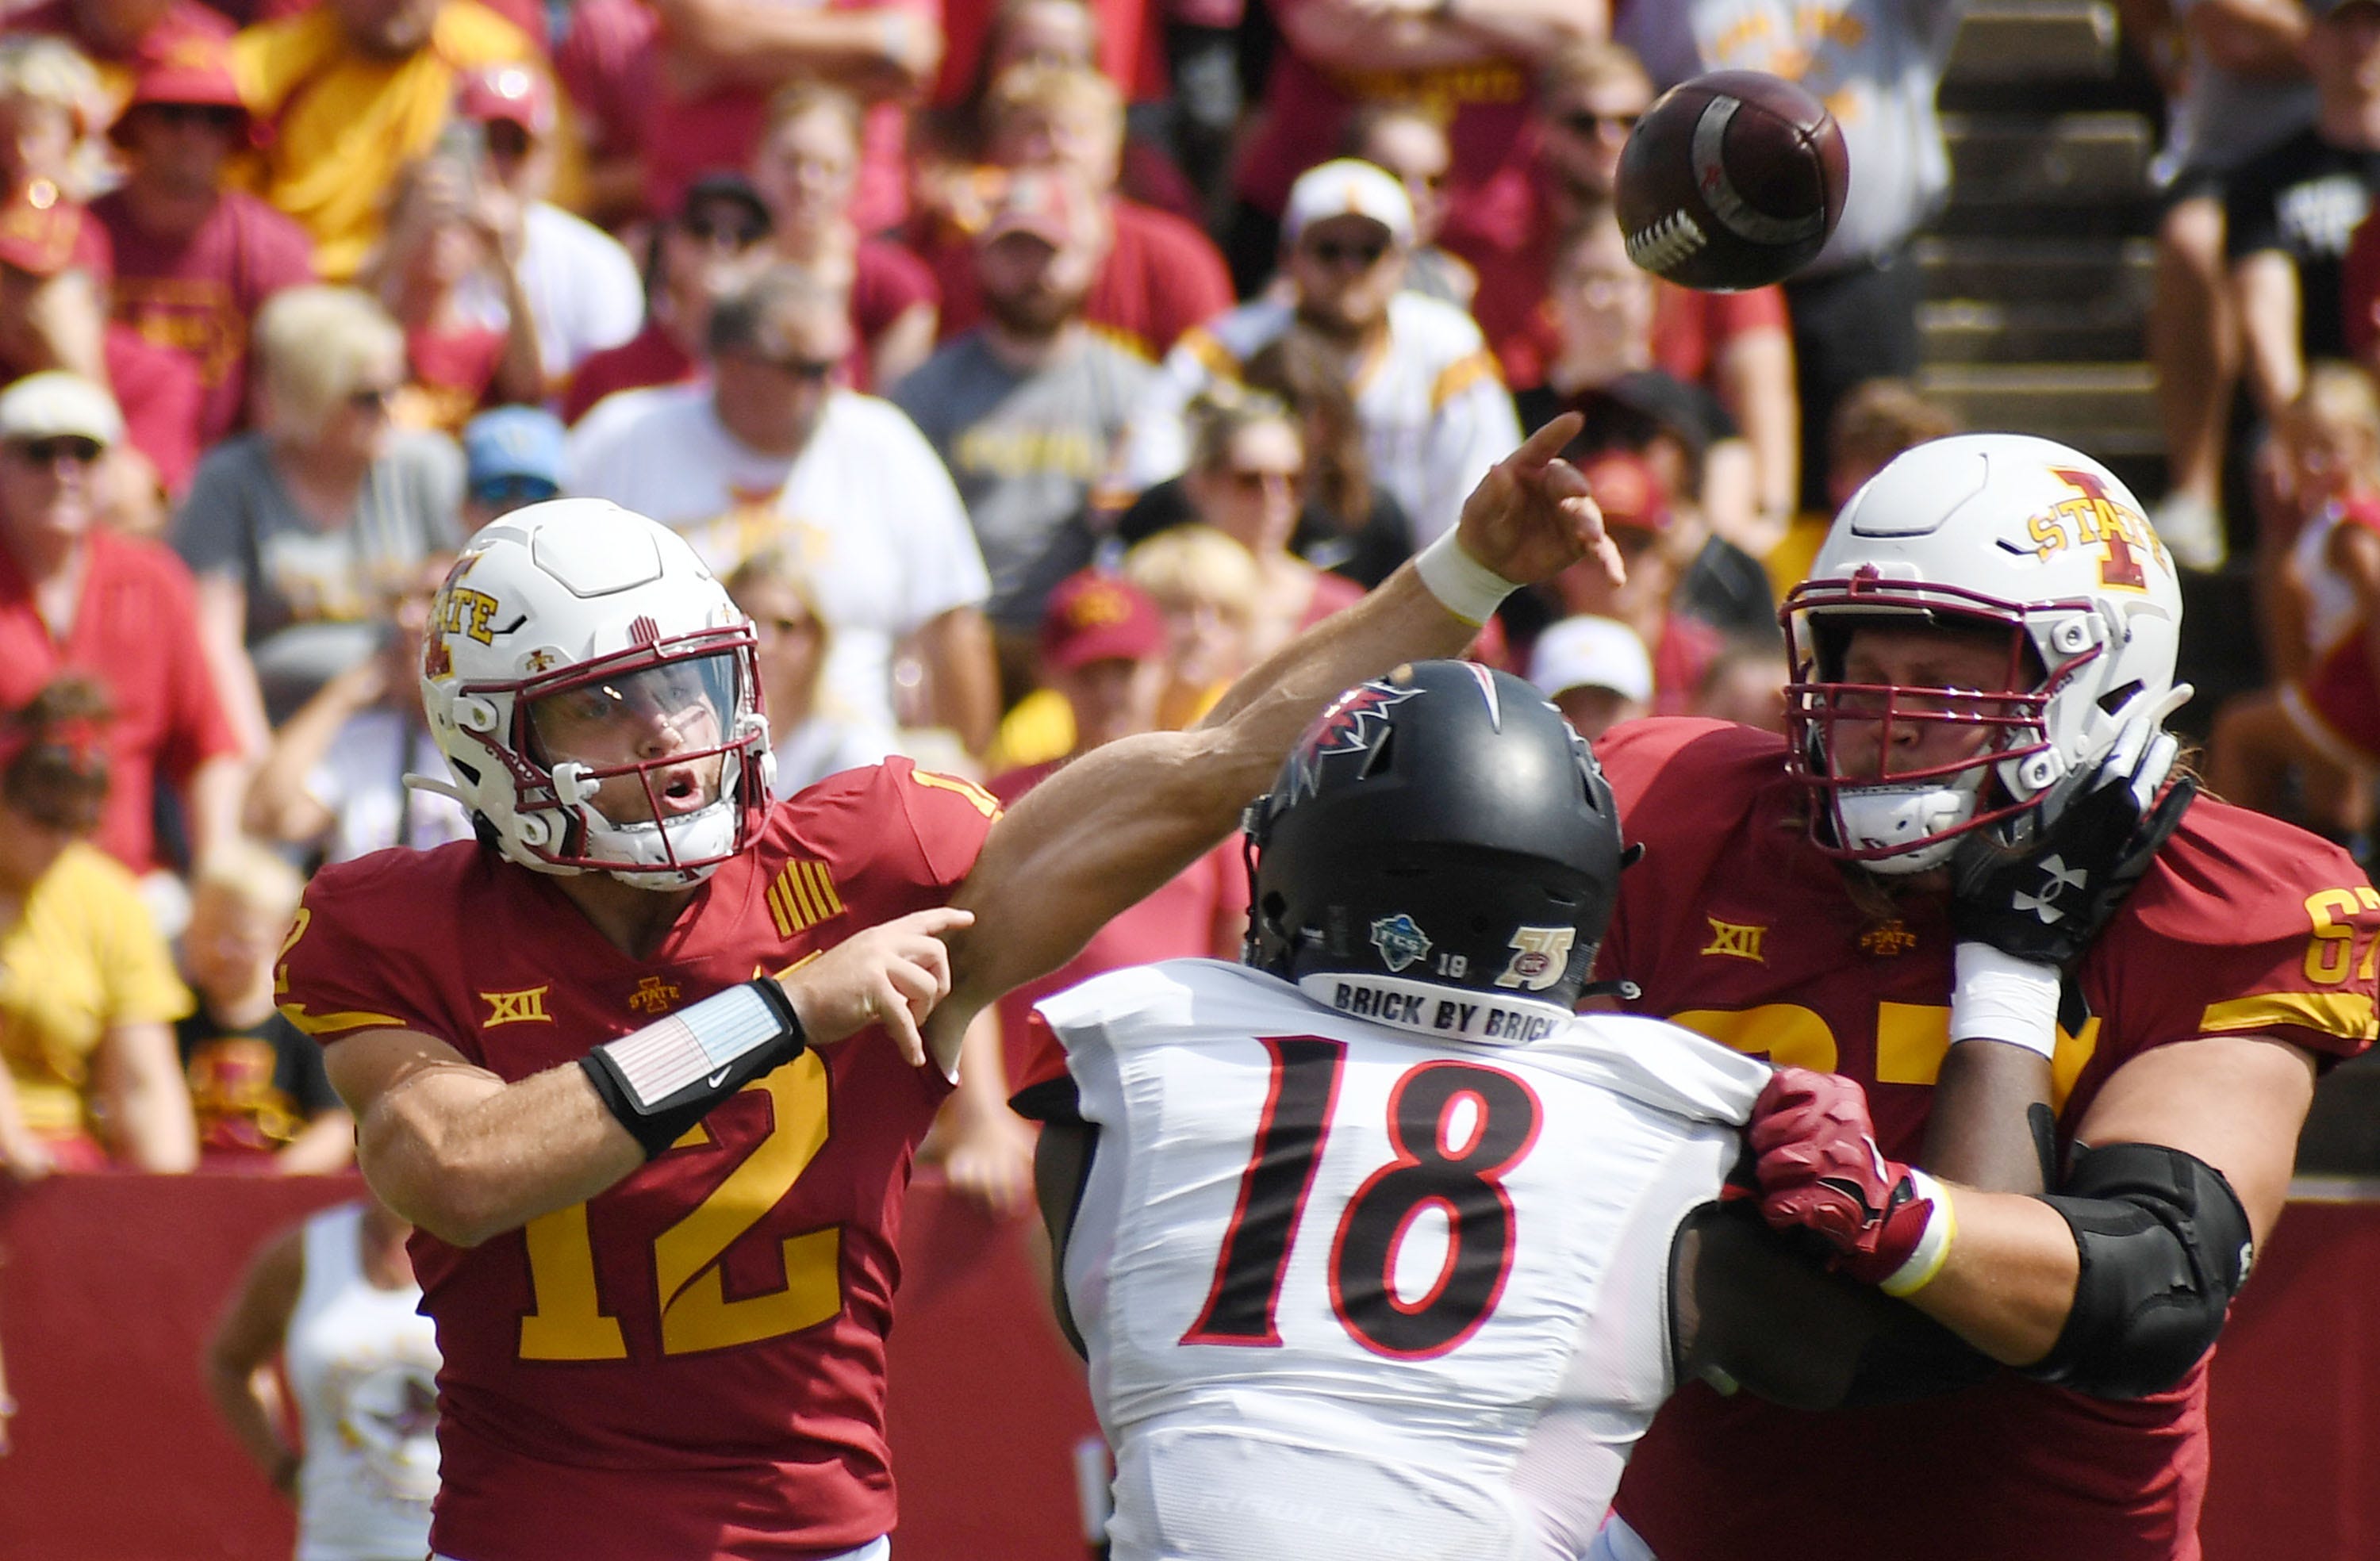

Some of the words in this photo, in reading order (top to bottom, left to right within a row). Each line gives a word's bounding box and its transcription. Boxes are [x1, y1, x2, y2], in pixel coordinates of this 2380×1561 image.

[1494, 925, 1576, 991] 75
[1699, 916, 1768, 963] XII
[2304, 884, 2380, 984] 67
[1437, 953, 1468, 979] 18
[480, 985, 552, 1028] XII
[628, 985, 681, 1011] STATE
[1334, 982, 1426, 1026] BRICK
[1434, 999, 1478, 1033] BY
[1178, 1034, 1544, 1361] 18
